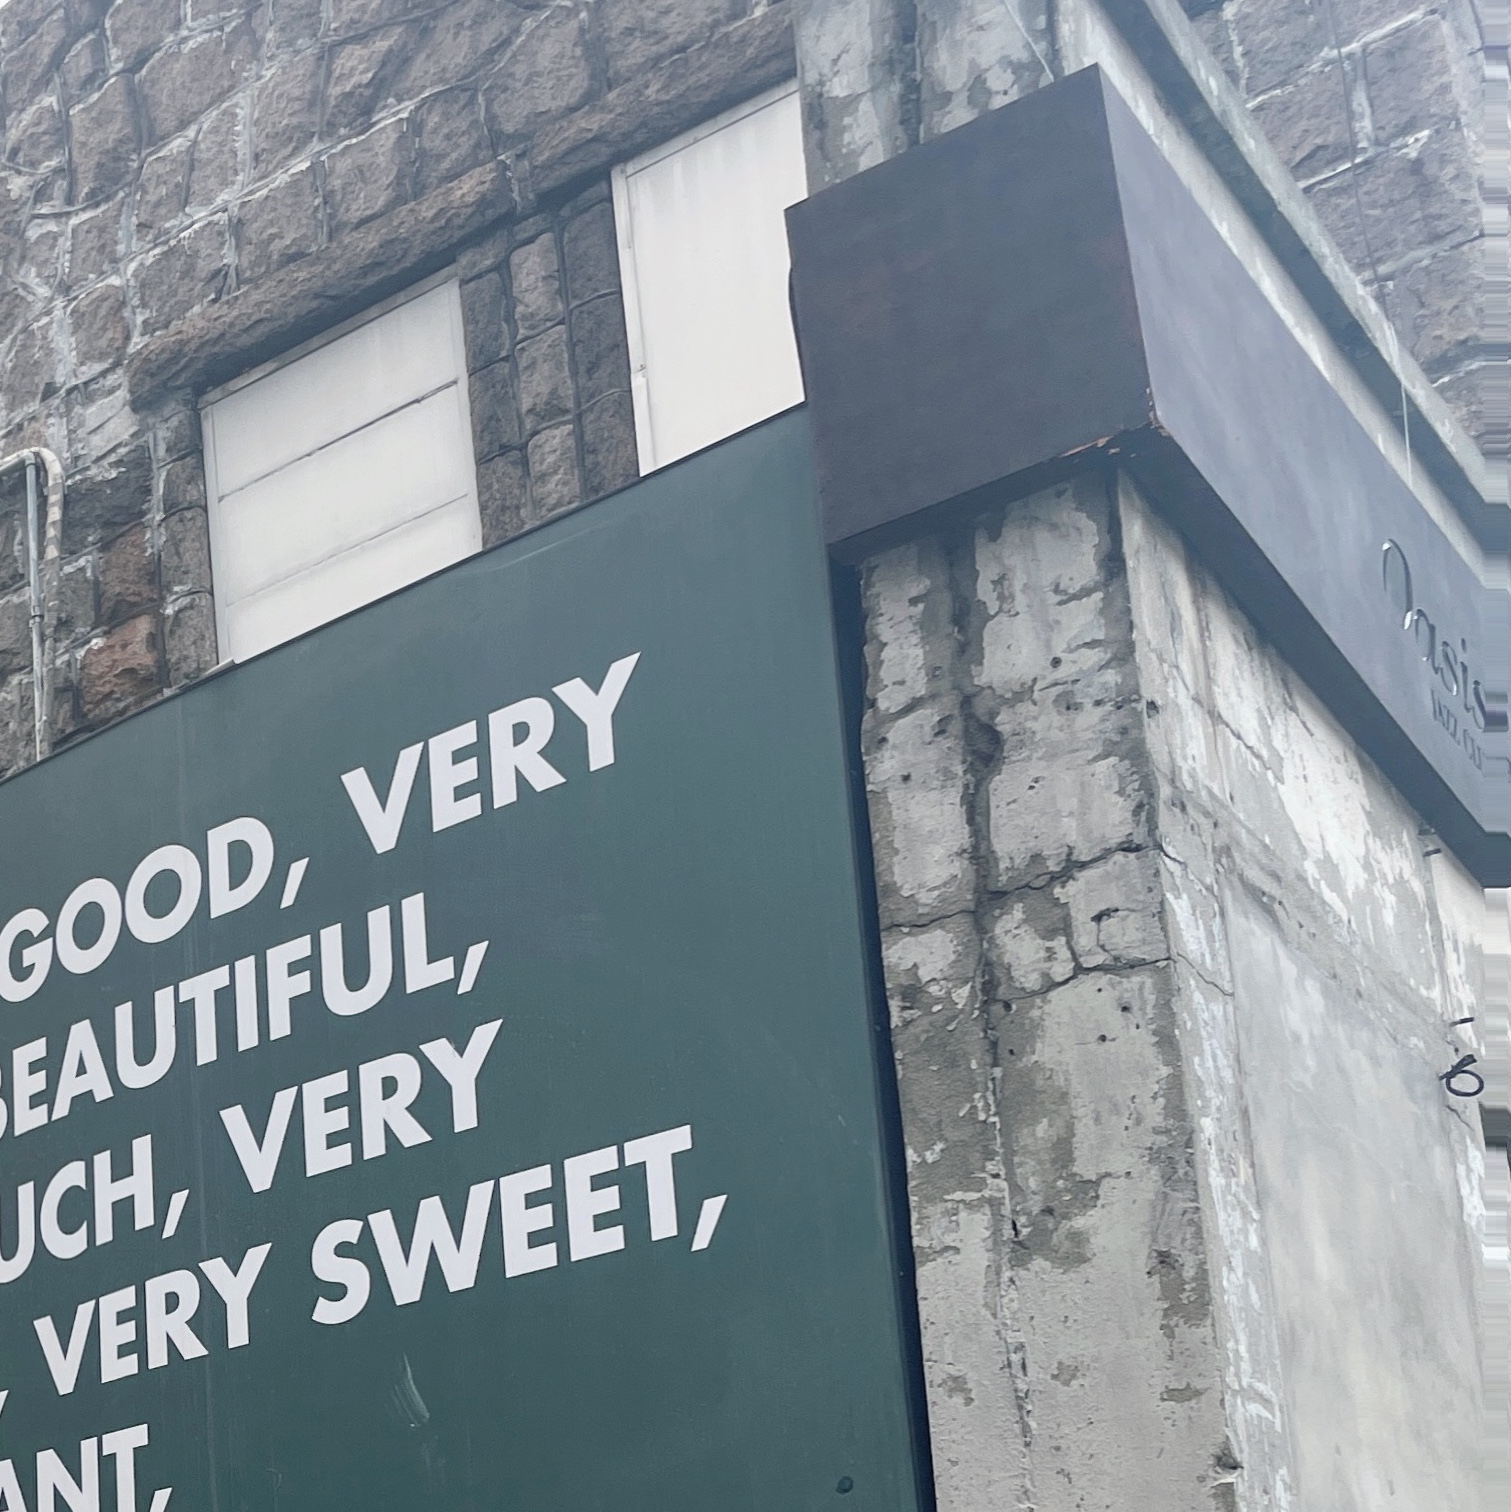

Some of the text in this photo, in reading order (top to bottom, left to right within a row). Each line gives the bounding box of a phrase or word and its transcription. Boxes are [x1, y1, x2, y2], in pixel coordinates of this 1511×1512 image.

[341, 652, 641, 854] VERY
[218, 1018, 504, 1193] VERY
[33, 1244, 272, 1396] VERY
[310, 1123, 729, 1326] SWEET,
